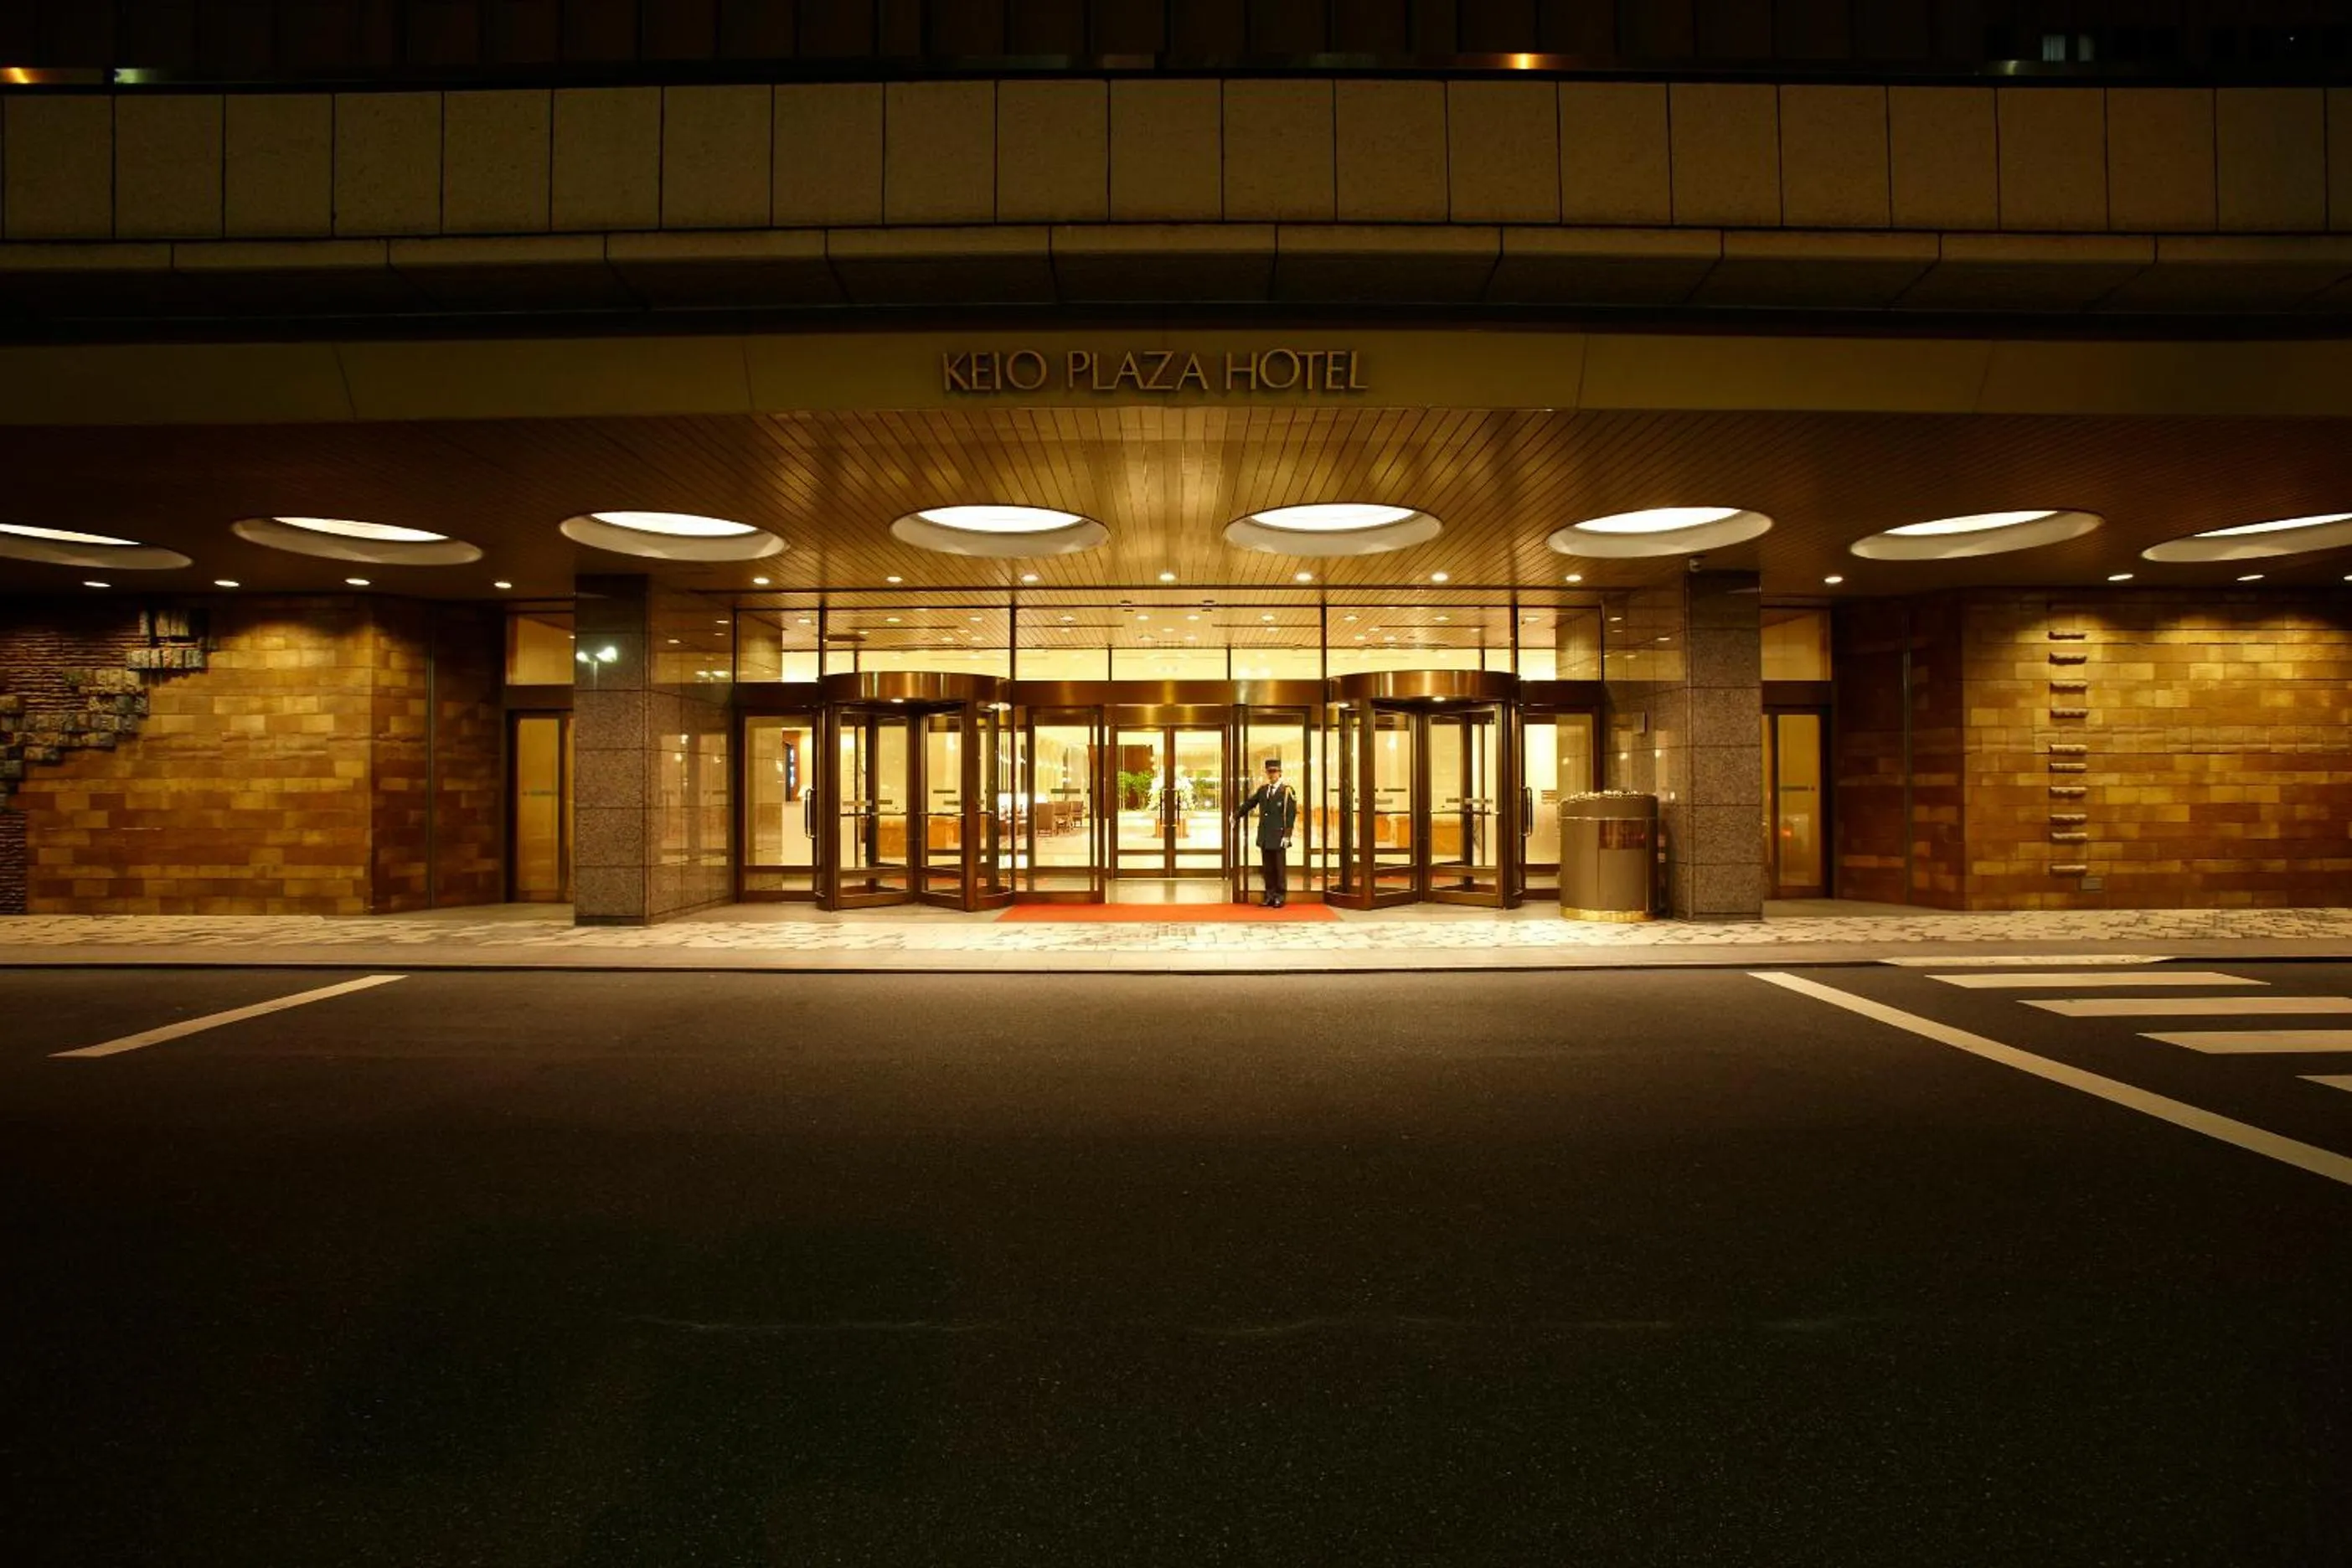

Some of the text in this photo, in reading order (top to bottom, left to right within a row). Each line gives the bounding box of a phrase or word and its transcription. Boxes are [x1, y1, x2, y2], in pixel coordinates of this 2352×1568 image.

[941, 348, 1369, 393] KEIO PLAZA HOTEL
